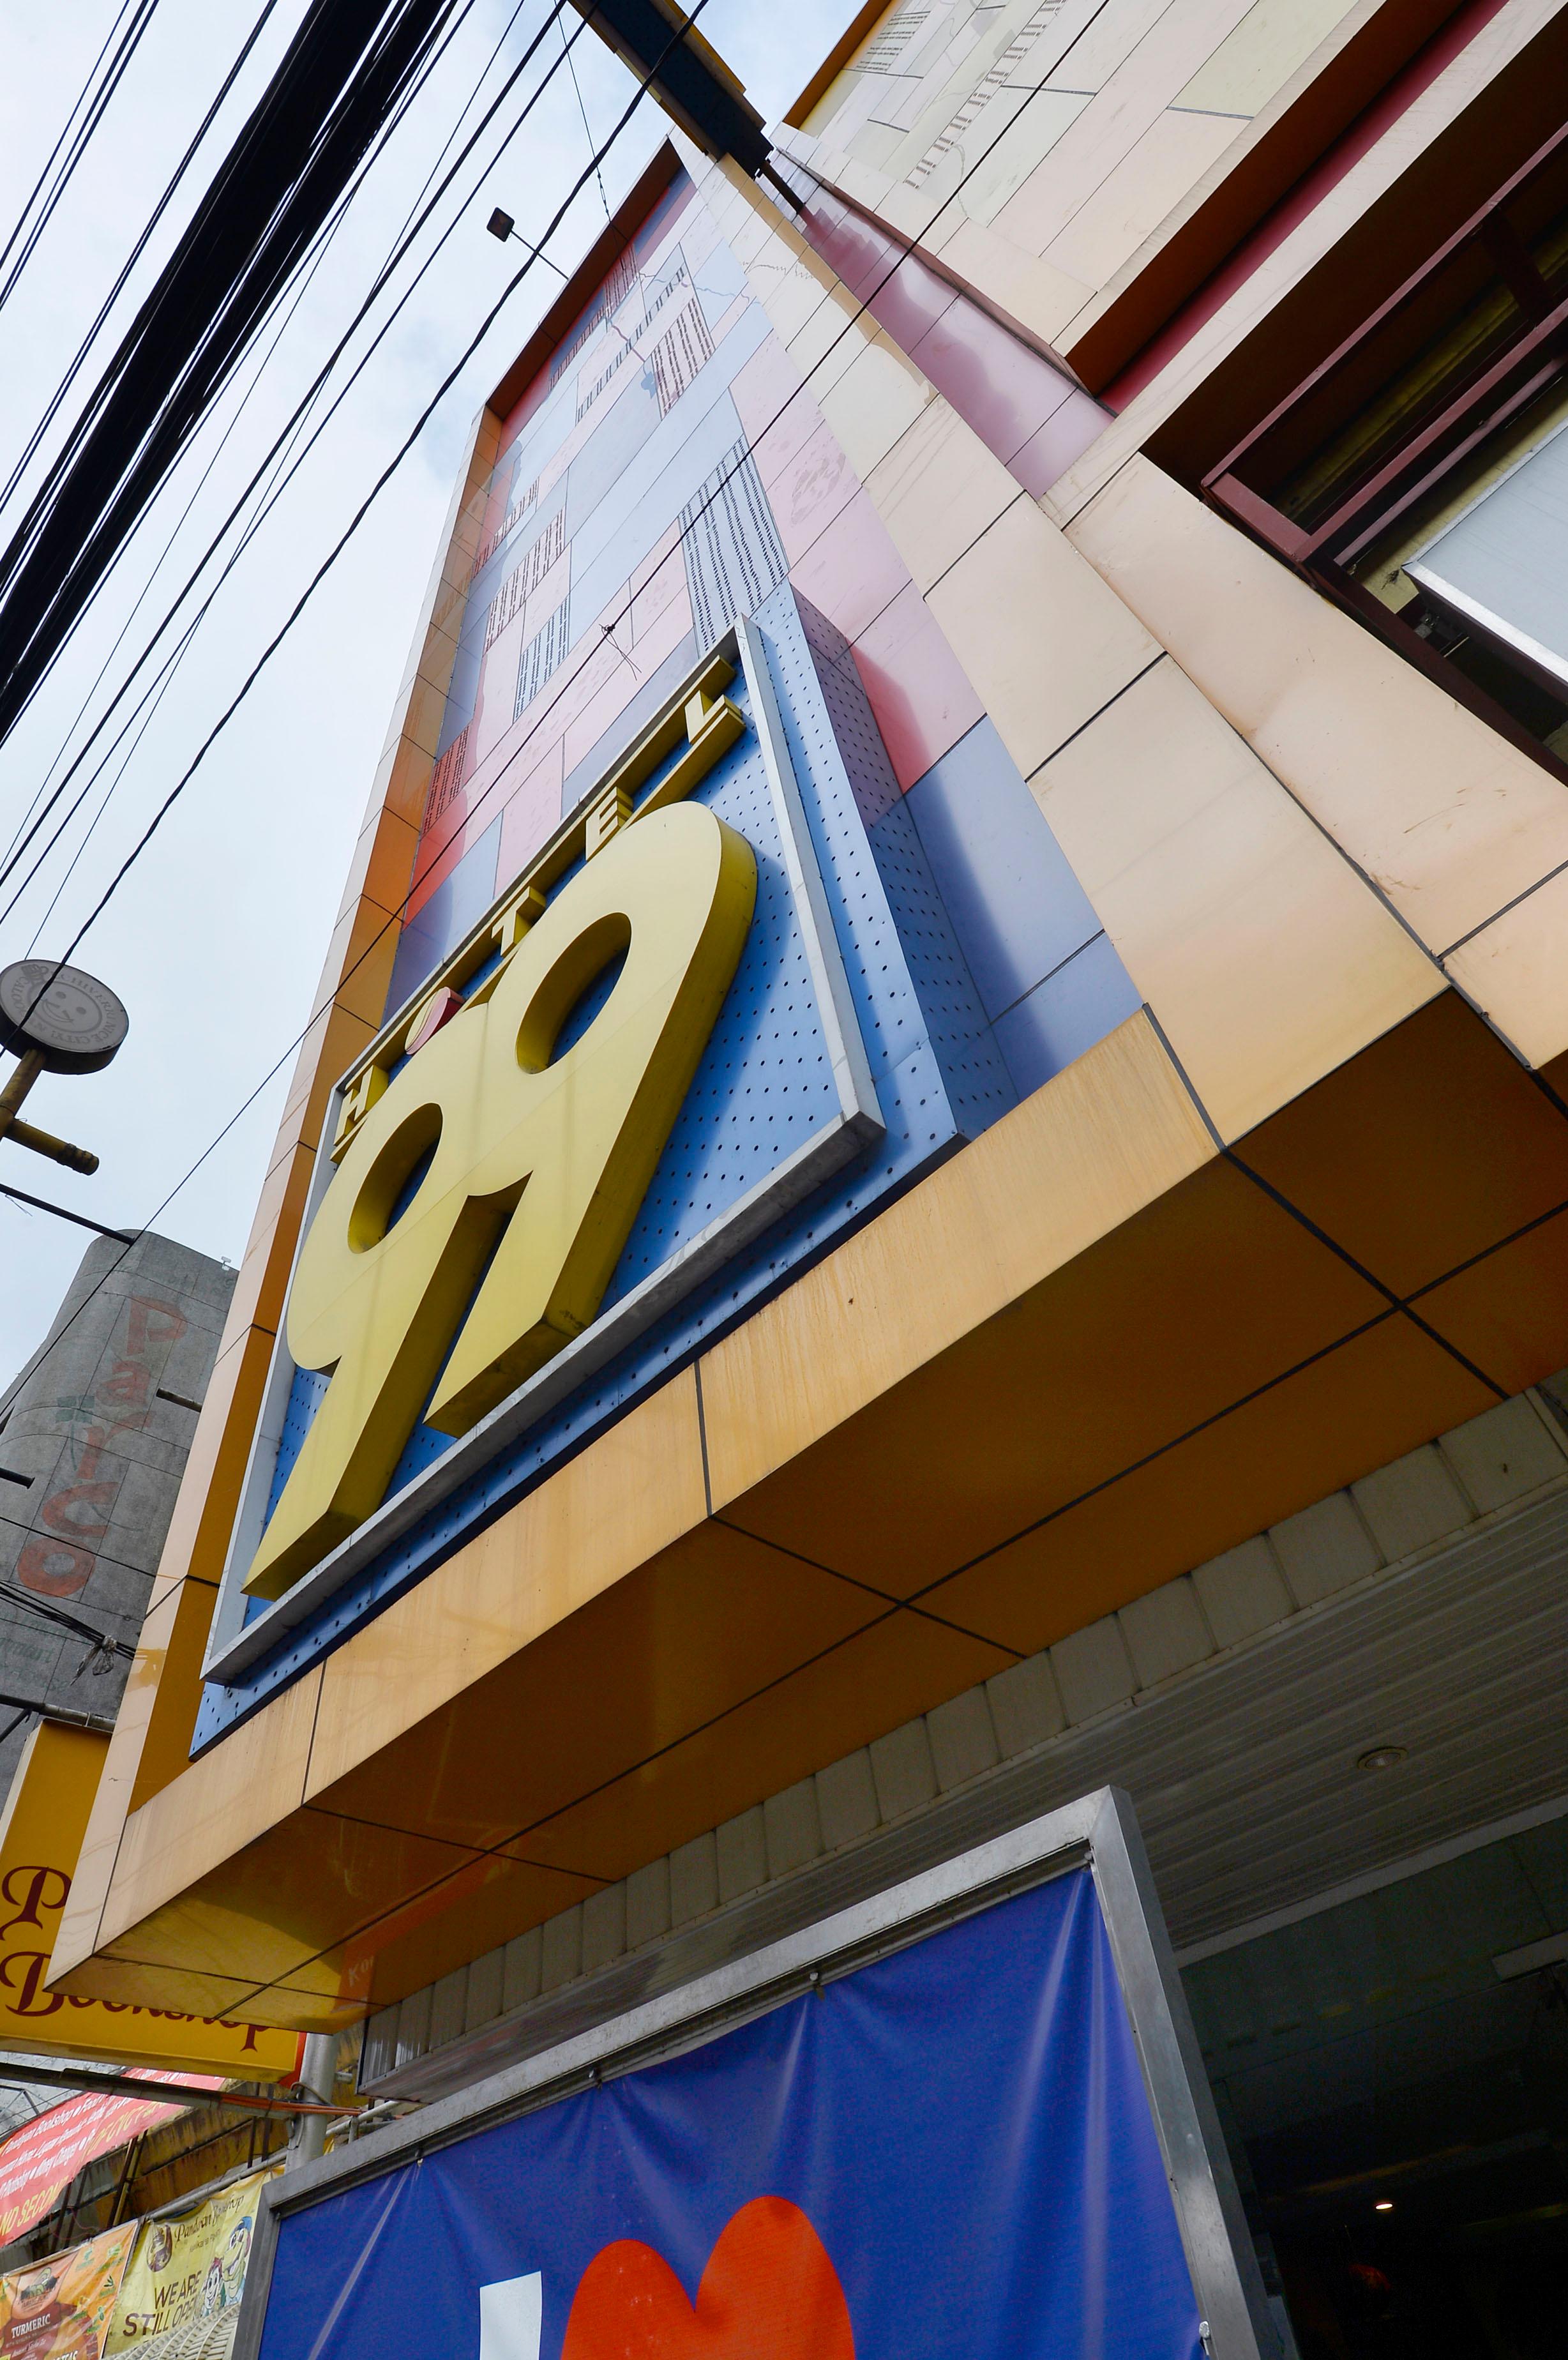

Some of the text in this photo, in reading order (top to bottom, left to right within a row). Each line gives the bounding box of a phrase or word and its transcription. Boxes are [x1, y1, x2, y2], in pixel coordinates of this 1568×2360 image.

[333, 690, 742, 1147] HOTEL
[243, 801, 758, 1596] 99
[155, 2271, 202, 2310] WE ARE
[11, 2313, 50, 2339] TURMERIC
[123, 2309, 170, 2336] STILL
